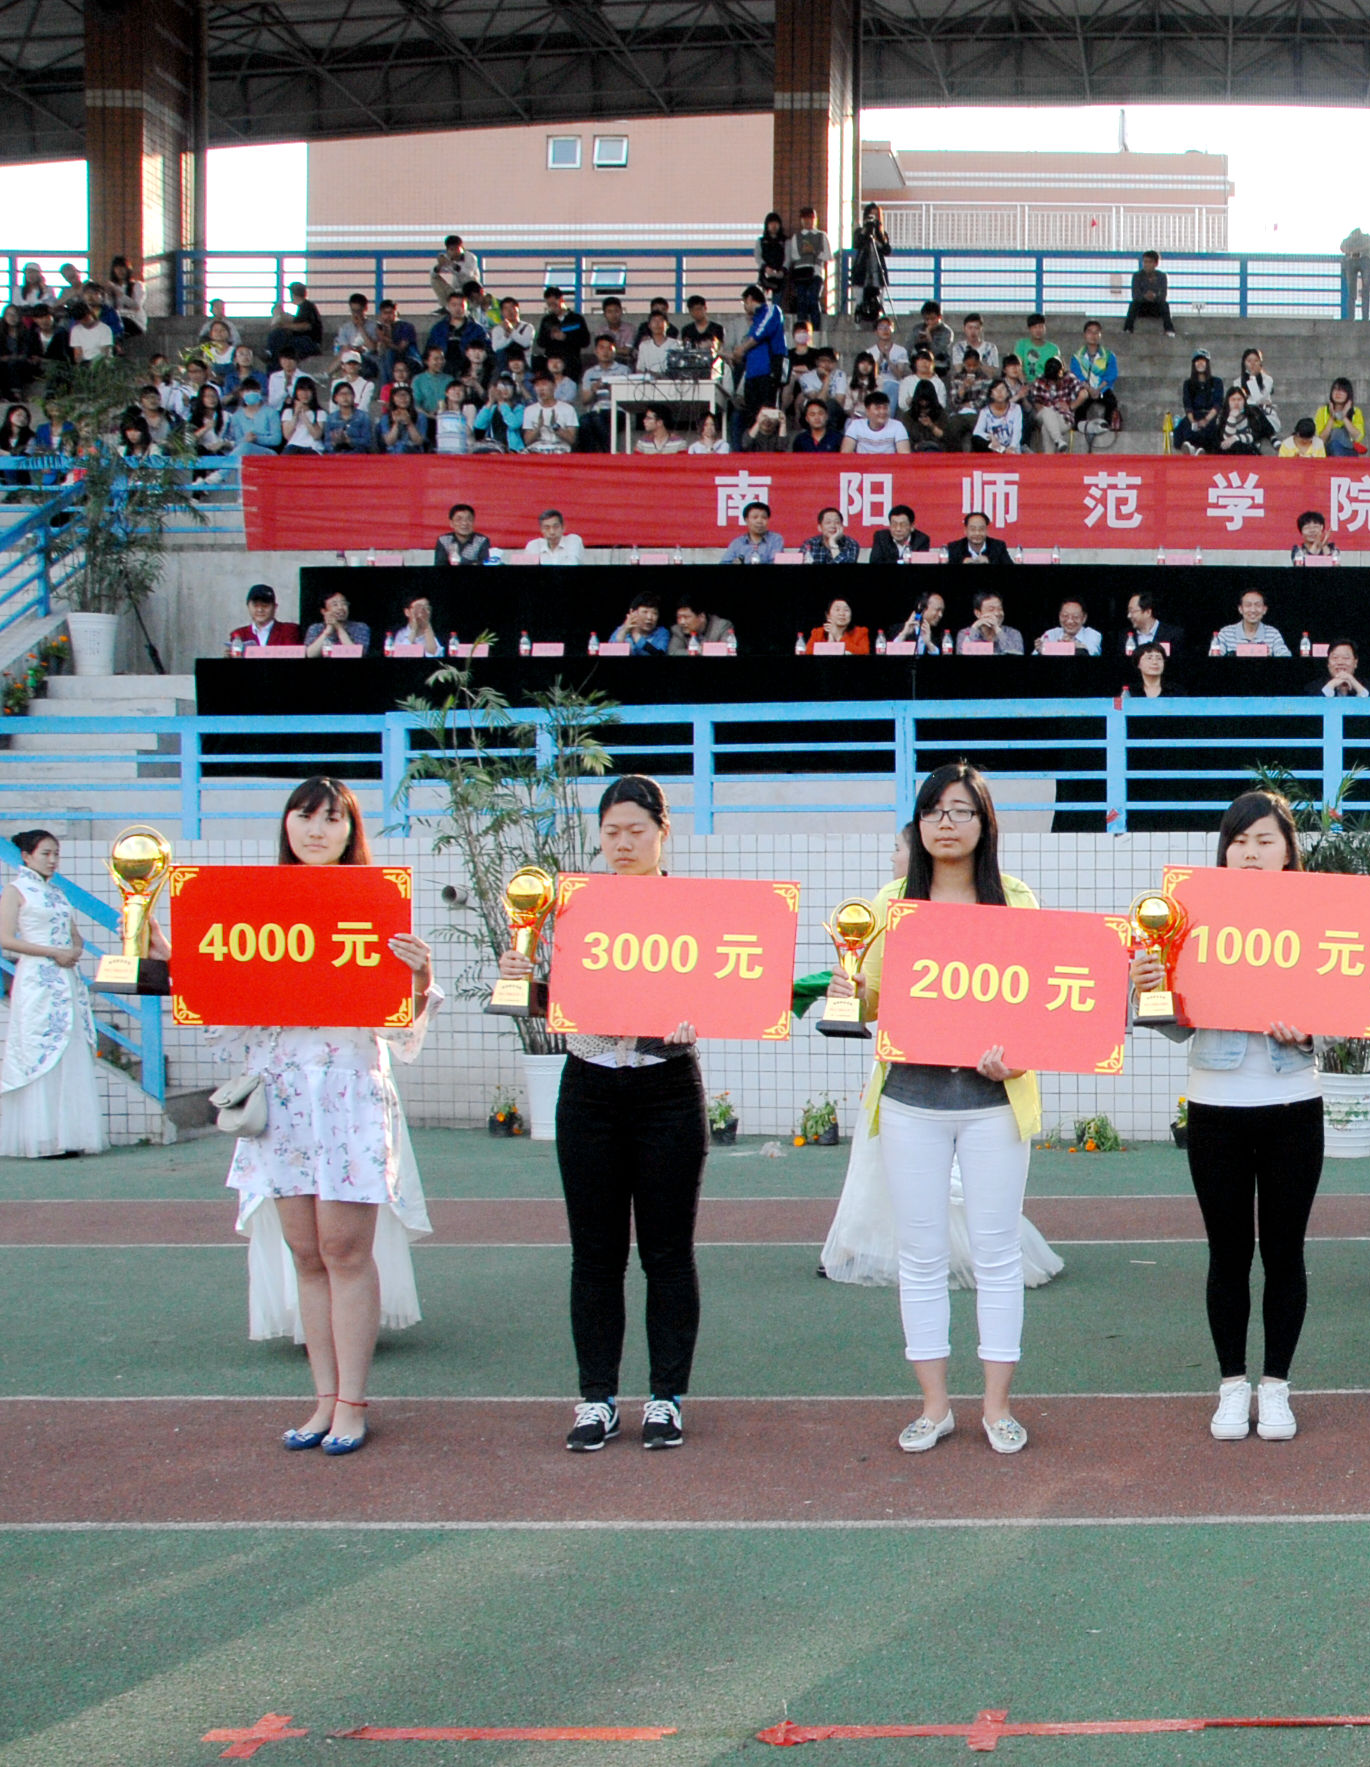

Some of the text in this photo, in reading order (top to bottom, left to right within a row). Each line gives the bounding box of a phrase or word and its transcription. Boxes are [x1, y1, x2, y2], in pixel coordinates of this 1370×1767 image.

[199, 922, 380, 967] 4000 元
[581, 931, 764, 979] 3000 元
[1190, 925, 1366, 976] 1000 元
[909, 959, 1096, 1012] 2000 元
